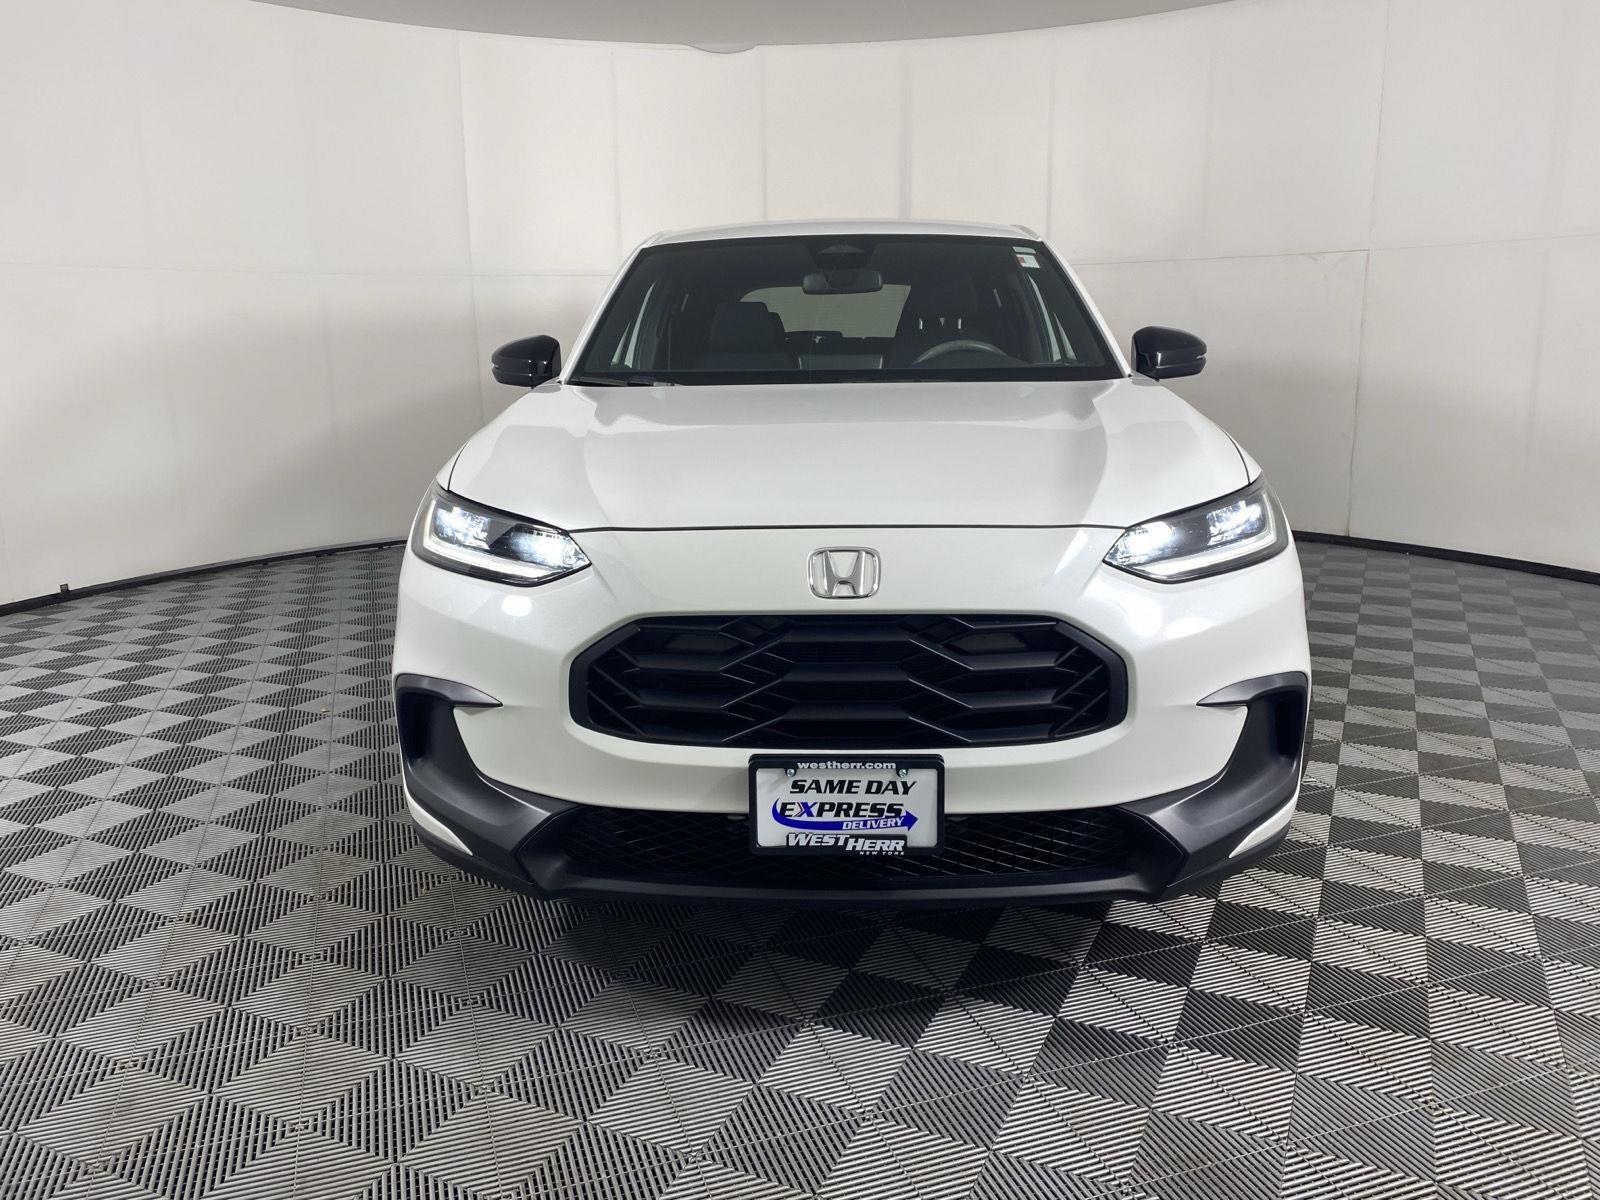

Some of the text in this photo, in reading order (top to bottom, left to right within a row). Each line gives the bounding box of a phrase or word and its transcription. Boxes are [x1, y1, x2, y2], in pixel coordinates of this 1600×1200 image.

[797, 761, 896, 769] westherr.com
[789, 779, 917, 795] SAME DAY
[779, 801, 904, 818] EXPRESS
[842, 816, 904, 830] DELIVERY
